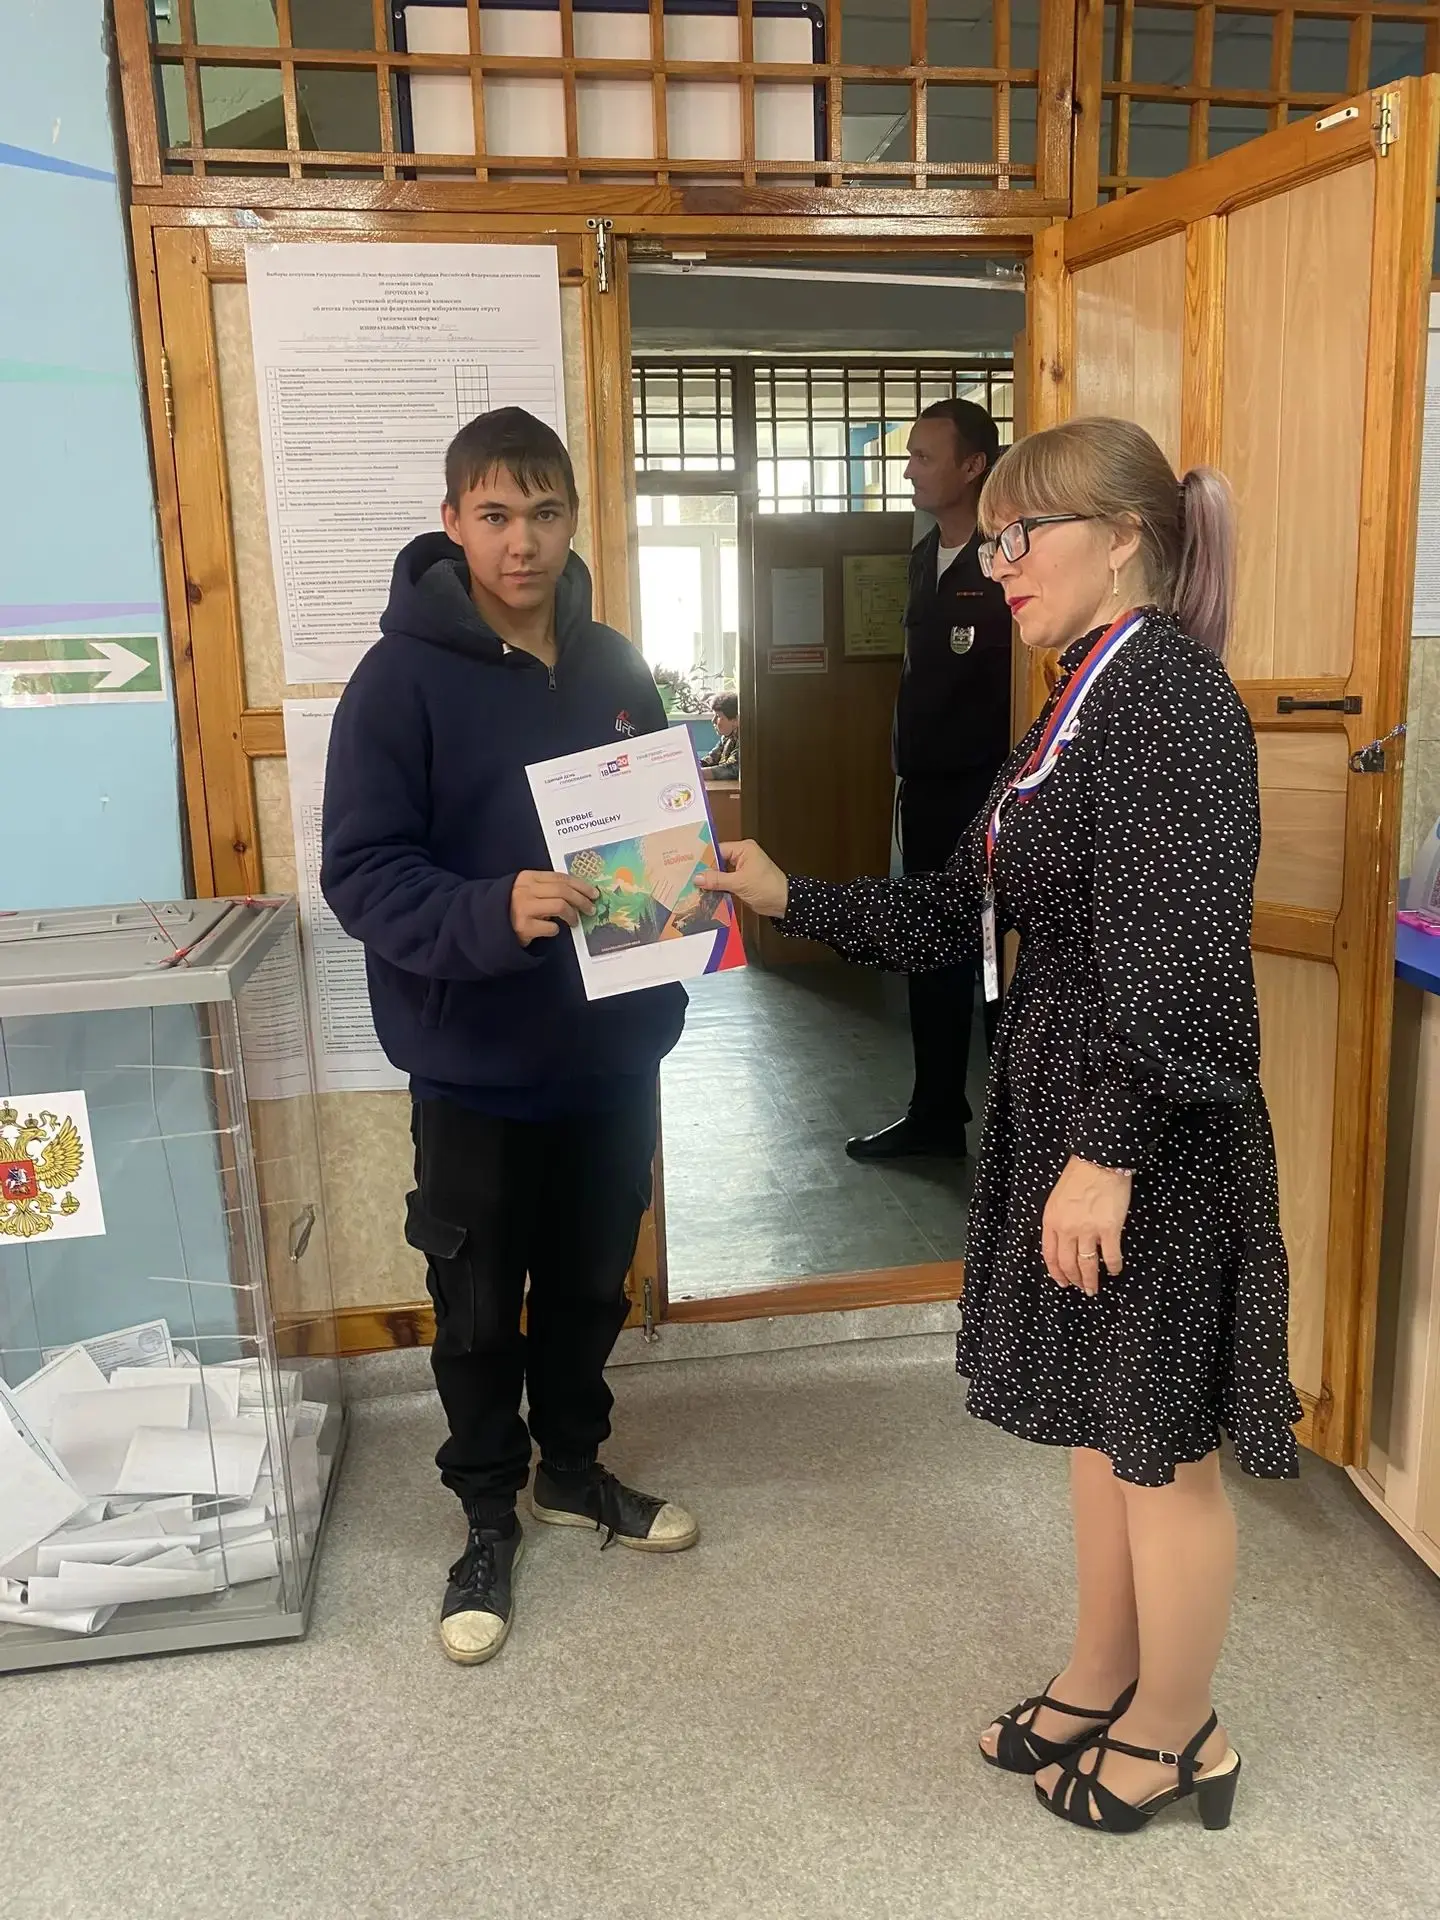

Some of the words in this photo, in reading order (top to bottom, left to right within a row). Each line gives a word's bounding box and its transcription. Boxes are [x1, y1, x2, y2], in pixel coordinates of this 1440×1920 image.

[601, 769, 610, 777] 18
[608, 762, 618, 771] 19
[554, 811, 594, 827] ВПЕРВЫЕ
[557, 814, 621, 836] ГОЛОСУЮЩЕМУ
